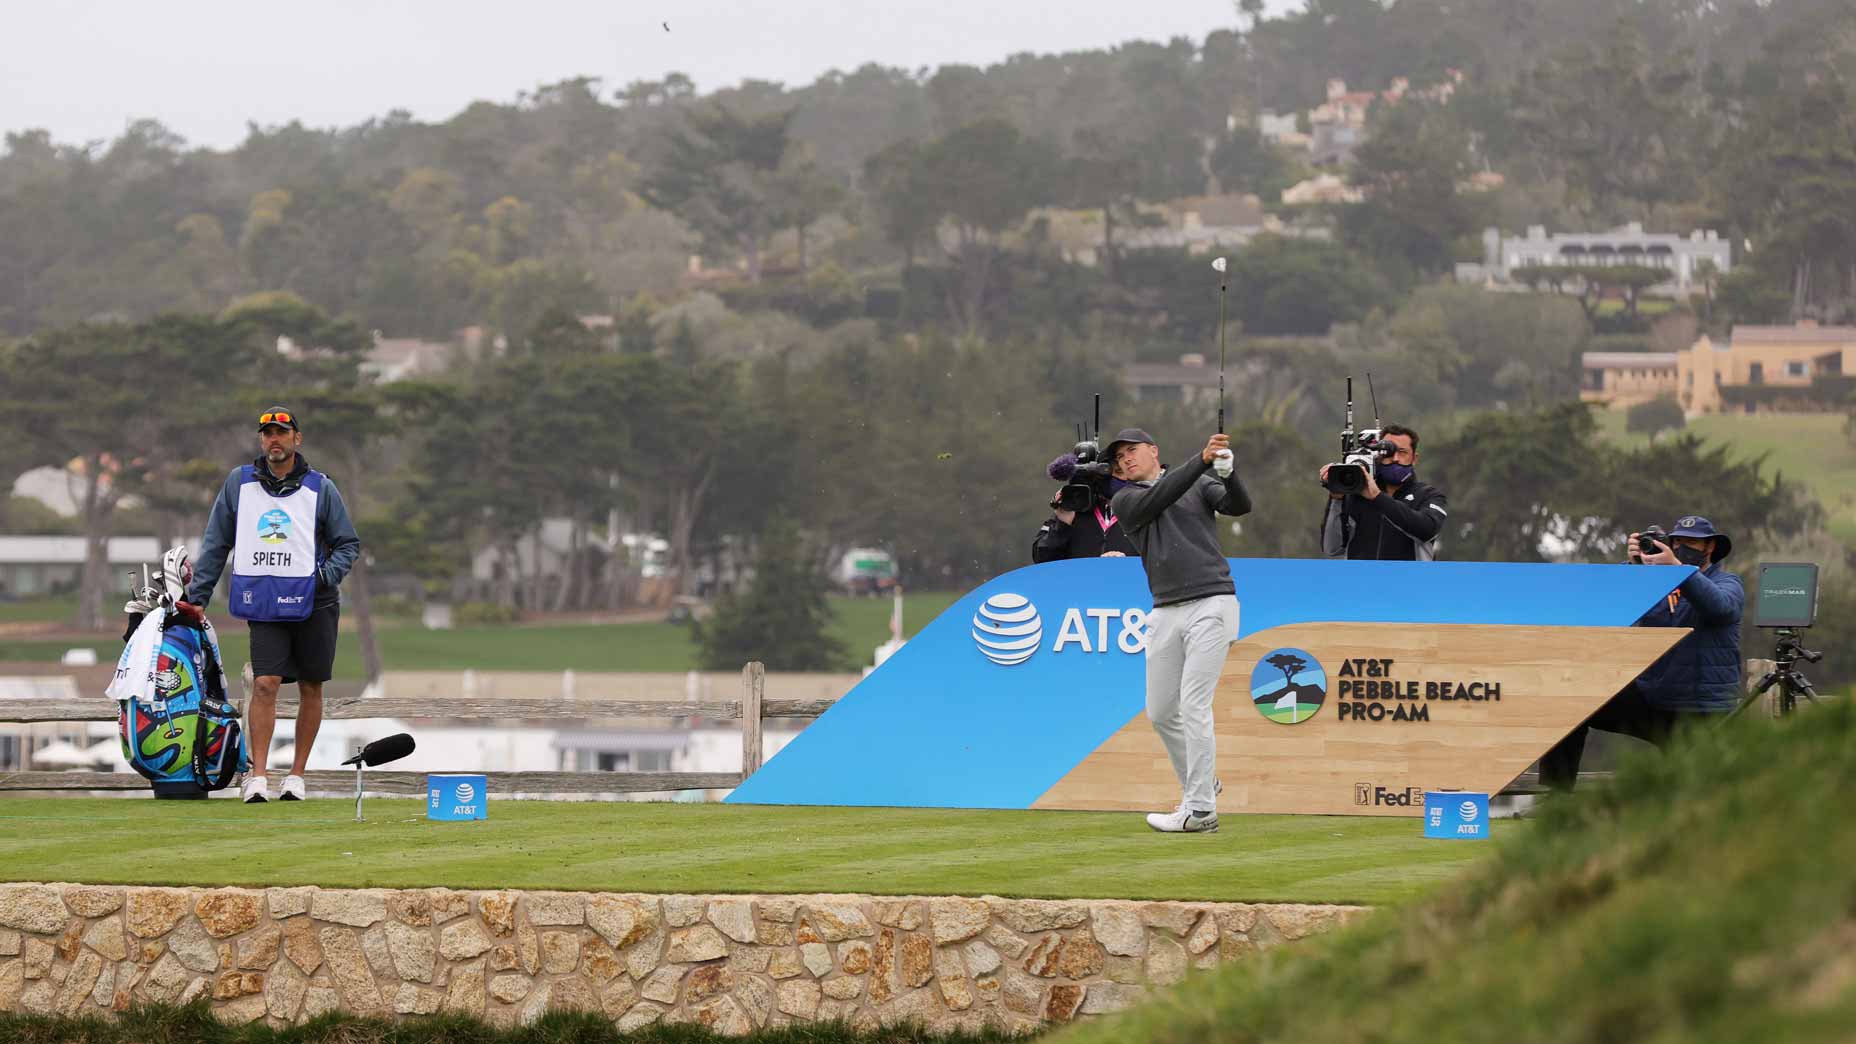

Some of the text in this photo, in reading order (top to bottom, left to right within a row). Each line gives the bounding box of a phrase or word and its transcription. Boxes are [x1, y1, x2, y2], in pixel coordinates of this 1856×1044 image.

[253, 552, 291, 566] SPIETH
[1053, 608, 1147, 653] AT&
[1338, 658, 1394, 677] AT&T
[1338, 680, 1500, 701] PEBBLE BEACH
[1338, 702, 1430, 721] PRO-AM
[453, 805, 477, 815] AT&T
[1457, 824, 1480, 834] AT&T
